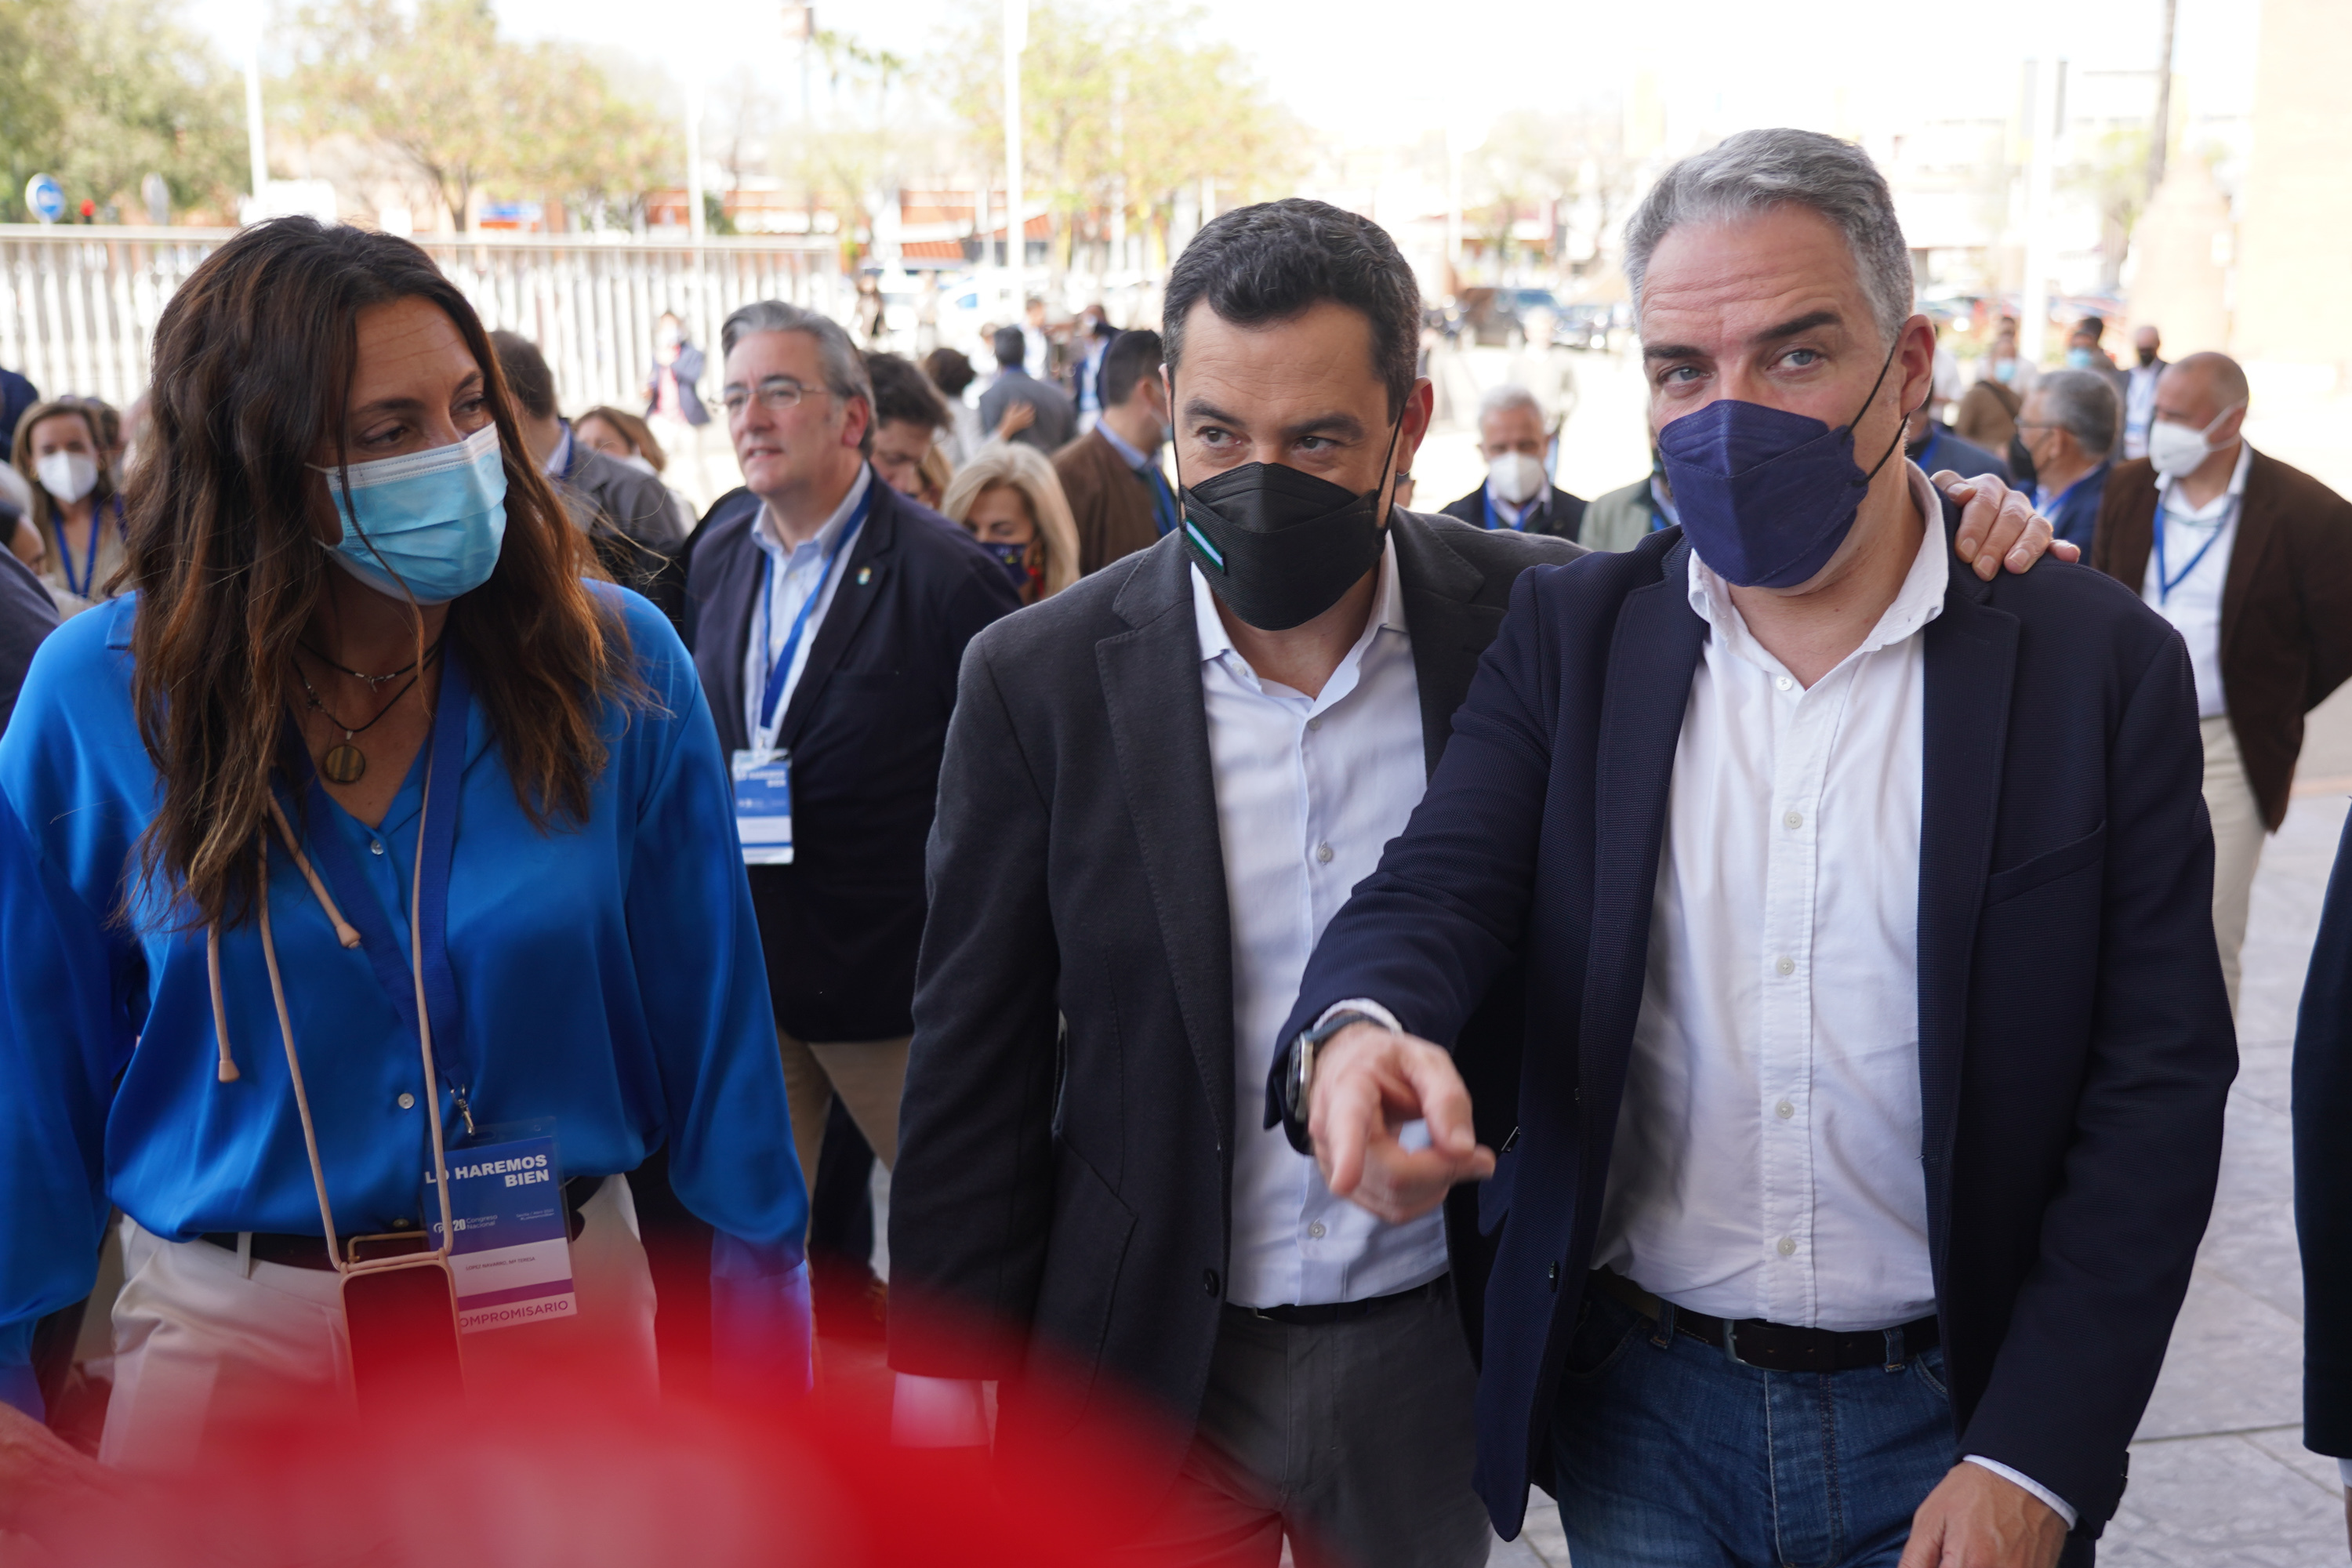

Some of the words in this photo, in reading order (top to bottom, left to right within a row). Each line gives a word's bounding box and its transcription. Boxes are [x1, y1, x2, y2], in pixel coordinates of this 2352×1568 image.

[455, 1154, 547, 1180] HAREMOS
[504, 1169, 550, 1188] BIEN
[452, 1219, 466, 1231] 20
[466, 1214, 498, 1224] Congreso
[467, 1221, 496, 1230] Nacional
[459, 1301, 568, 1327] OMPROMISARIO
